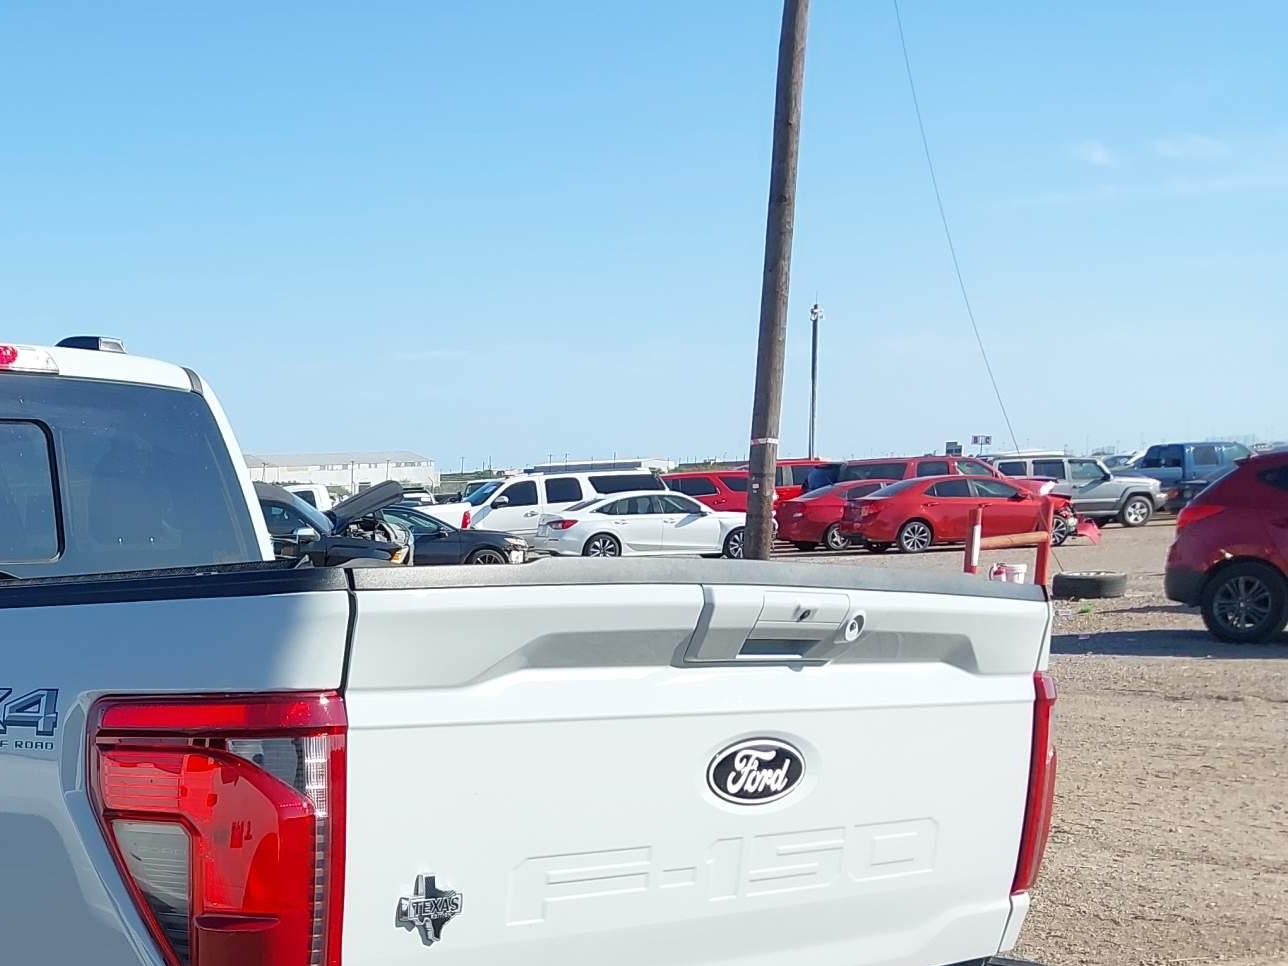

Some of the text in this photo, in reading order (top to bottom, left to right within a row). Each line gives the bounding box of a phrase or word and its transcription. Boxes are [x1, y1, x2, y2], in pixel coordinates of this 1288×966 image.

[14, 740, 54, 750] ROAD
[726, 749, 791, 794] Ford
[506, 817, 939, 926] F-150
[412, 896, 460, 917] TEXAS
